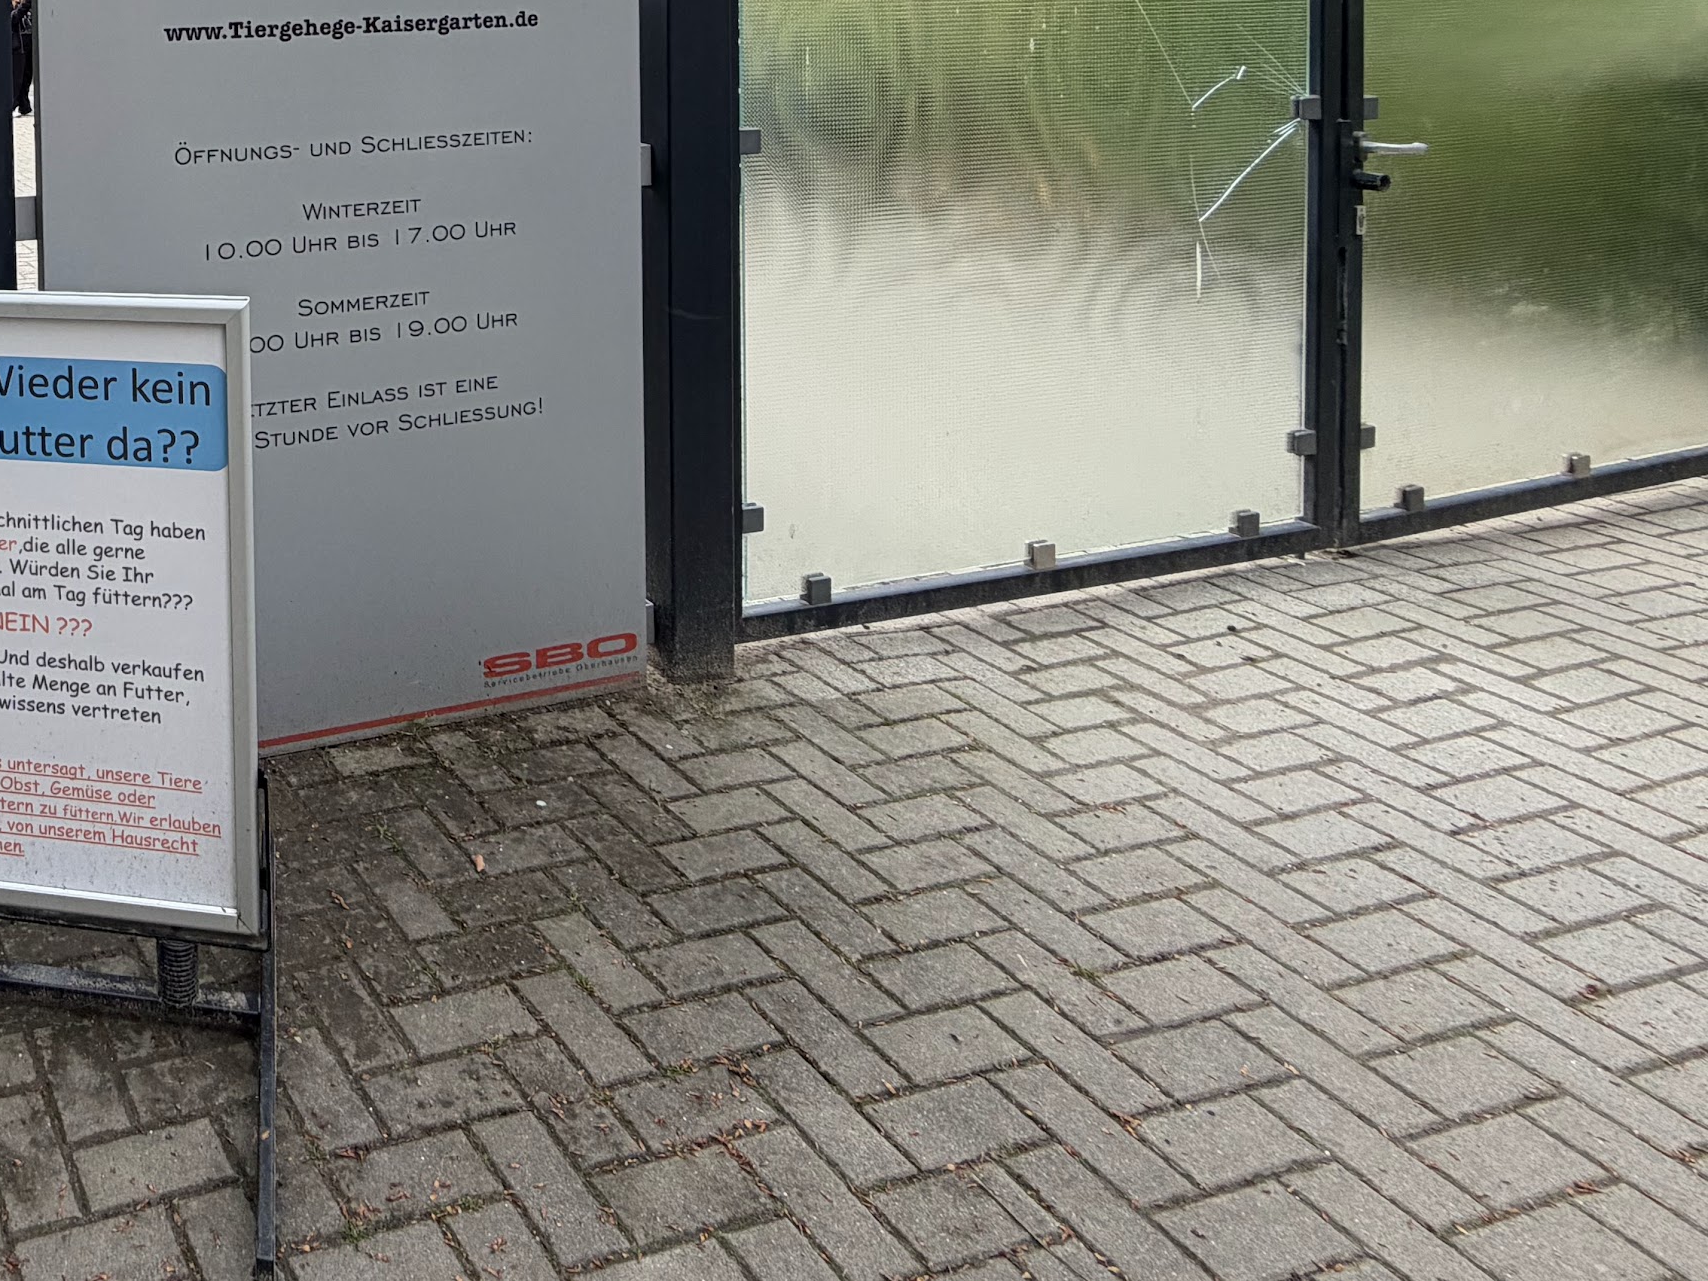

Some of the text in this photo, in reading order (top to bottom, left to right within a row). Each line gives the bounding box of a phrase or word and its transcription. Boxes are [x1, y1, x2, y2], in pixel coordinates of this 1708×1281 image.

[164, 11, 539, 42] www.Tiergehege-Kaisergarten.de
[205, 238, 282, 261] 10.00
[395, 223, 466, 246] 17.00
[249, 334, 284, 354] 00
[397, 316, 468, 339] 19.00
[131, 368, 211, 407] kein
[251, 397, 317, 418] TZTER
[107, 426, 200, 465] da??
[110, 518, 143, 541] Tag
[150, 520, 206, 541] haben
[56, 538, 87, 556] alle
[93, 545, 146, 562] gerne
[9, 559, 80, 579] Würden
[87, 565, 117, 581] Sie
[122, 566, 154, 584] Ihr
[22, 586, 47, 600] am
[53, 585, 86, 607] Tag
[92, 587, 194, 611] füttern???
[56, 617, 93, 637] ???
[36, 651, 105, 672] deshalb
[111, 659, 205, 682] verkaufen
[483, 632, 638, 679] SBO
[32, 674, 91, 697] Menge
[96, 683, 117, 697] an
[123, 681, 190, 706] Futter,
[71, 704, 162, 724] vertreten
[7, 758, 91, 781] untersagt,
[96, 768, 151, 784] unsere
[157, 771, 203, 790] Tiere
[0, 776, 45, 795] Obst,
[50, 781, 113, 801] Gemüse
[118, 790, 156, 805] oder
[39, 803, 57, 816] zu
[149, 814, 222, 836] erlauben
[7, 819, 34, 834] von
[39, 823, 106, 842] unserem
[112, 828, 199, 852] Hausrecht
